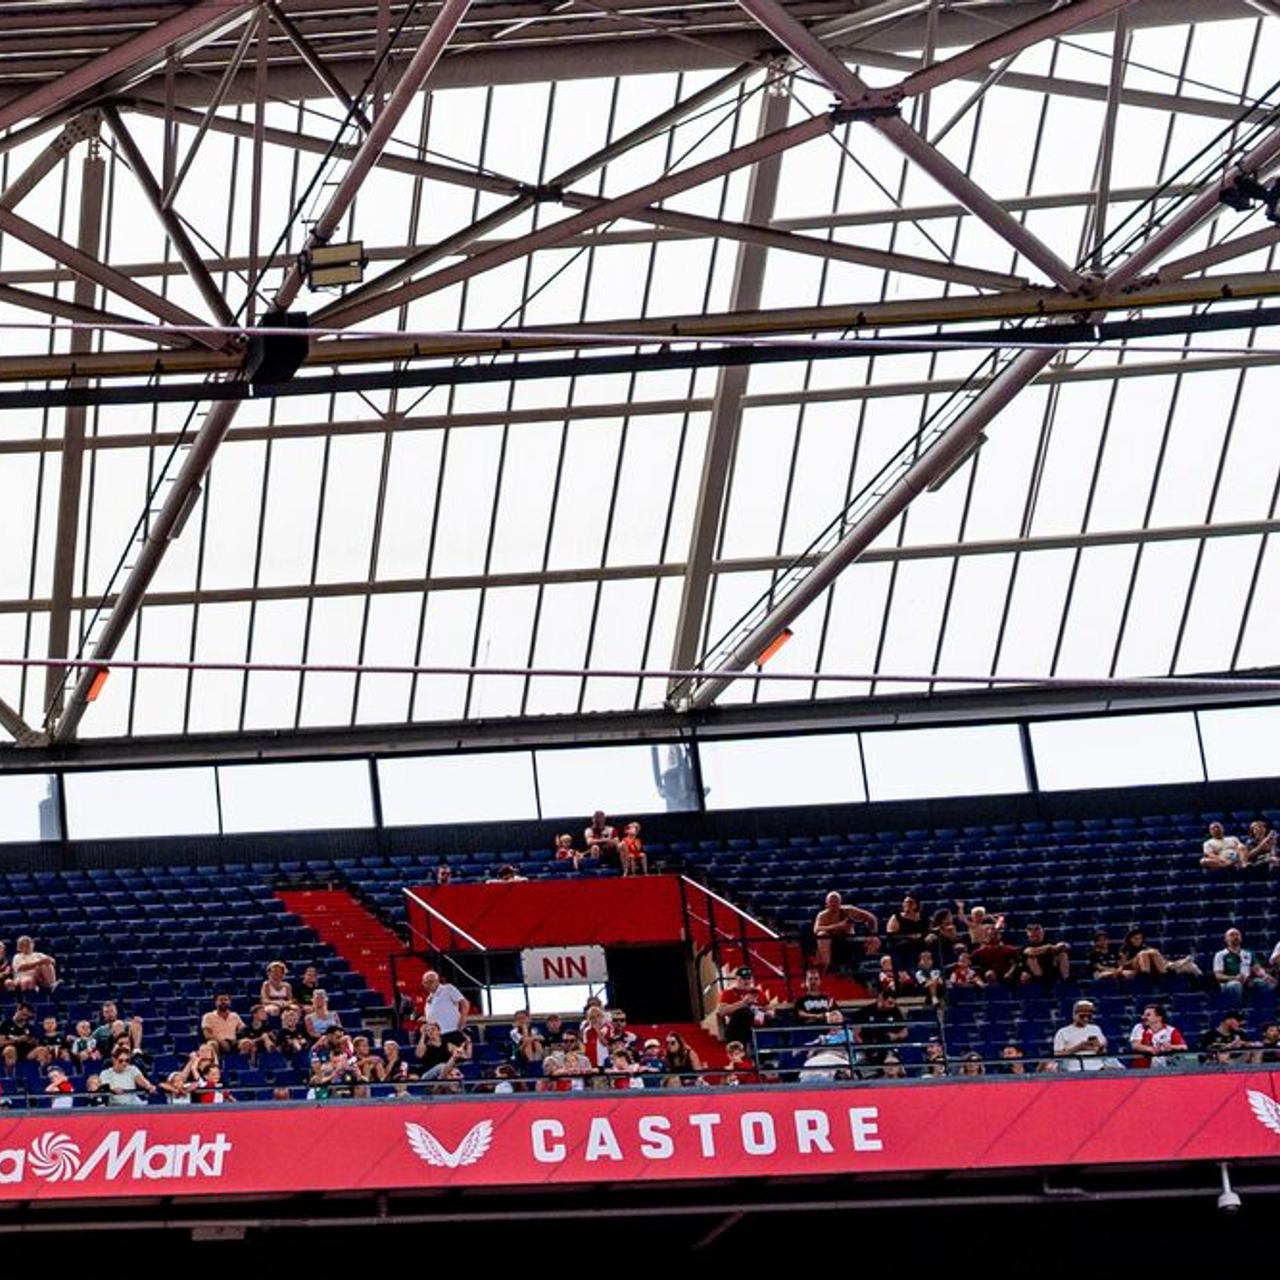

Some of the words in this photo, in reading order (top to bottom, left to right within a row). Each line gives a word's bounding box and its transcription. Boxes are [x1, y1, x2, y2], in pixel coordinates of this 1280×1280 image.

[542, 955, 588, 980] NN
[73, 1130, 232, 1181] Markt
[531, 1107, 883, 1163] CASTORE
